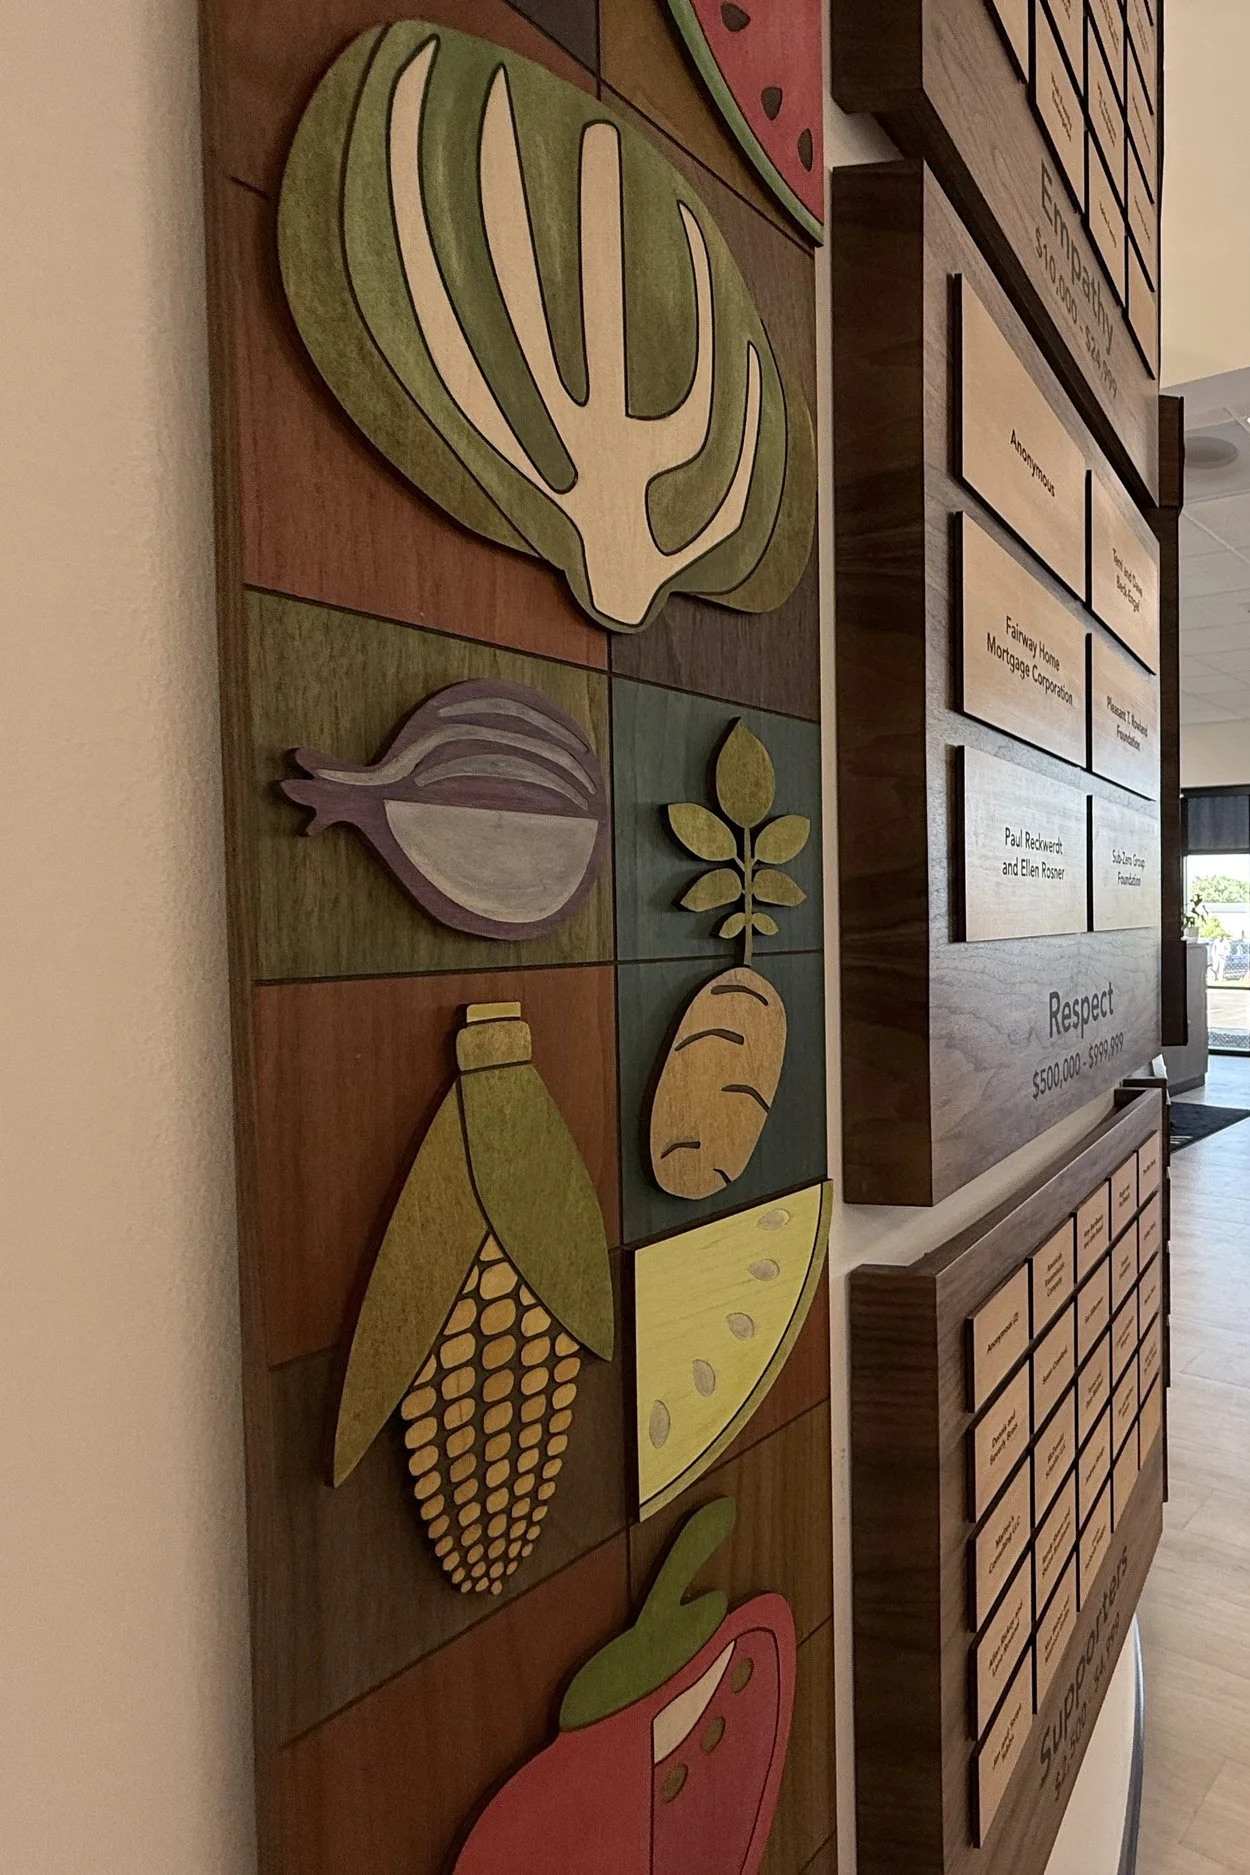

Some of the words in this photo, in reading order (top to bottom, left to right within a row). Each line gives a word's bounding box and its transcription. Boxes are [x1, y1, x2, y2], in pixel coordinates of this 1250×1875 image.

[1040, 158, 1114, 354] Empathy
[1035, 228, 1078, 326] $10,000
[1085, 326, 1118, 398] $24,999
[1010, 429, 1055, 497] Anonymous
[1123, 567, 1132, 584] and
[987, 632, 1030, 680] Mortgage
[1032, 664, 1073, 706] Corporation
[1006, 615, 1037, 659] Fairway
[1039, 641, 1060, 672] Home
[1107, 696, 1126, 722] Pleasant
[1131, 713, 1148, 738] Rowland
[1116, 724, 1140, 751] Foundation
[1002, 857, 1018, 876] and
[1021, 858, 1039, 878] Ellen
[1041, 861, 1065, 880] Rosner
[1005, 827, 1023, 847] Paul
[1025, 831, 1063, 855] Reckwerdt
[1112, 849, 1132, 866] Sub-Zero
[1133, 854, 1145, 871] Group
[1118, 871, 1141, 887] Foundation
[1049, 982, 1114, 1039] Respect
[1032, 1052, 1081, 1100] $500,000
[1088, 1032, 1124, 1069] $999,999
[1040, 1546, 1128, 1787] Supporters
